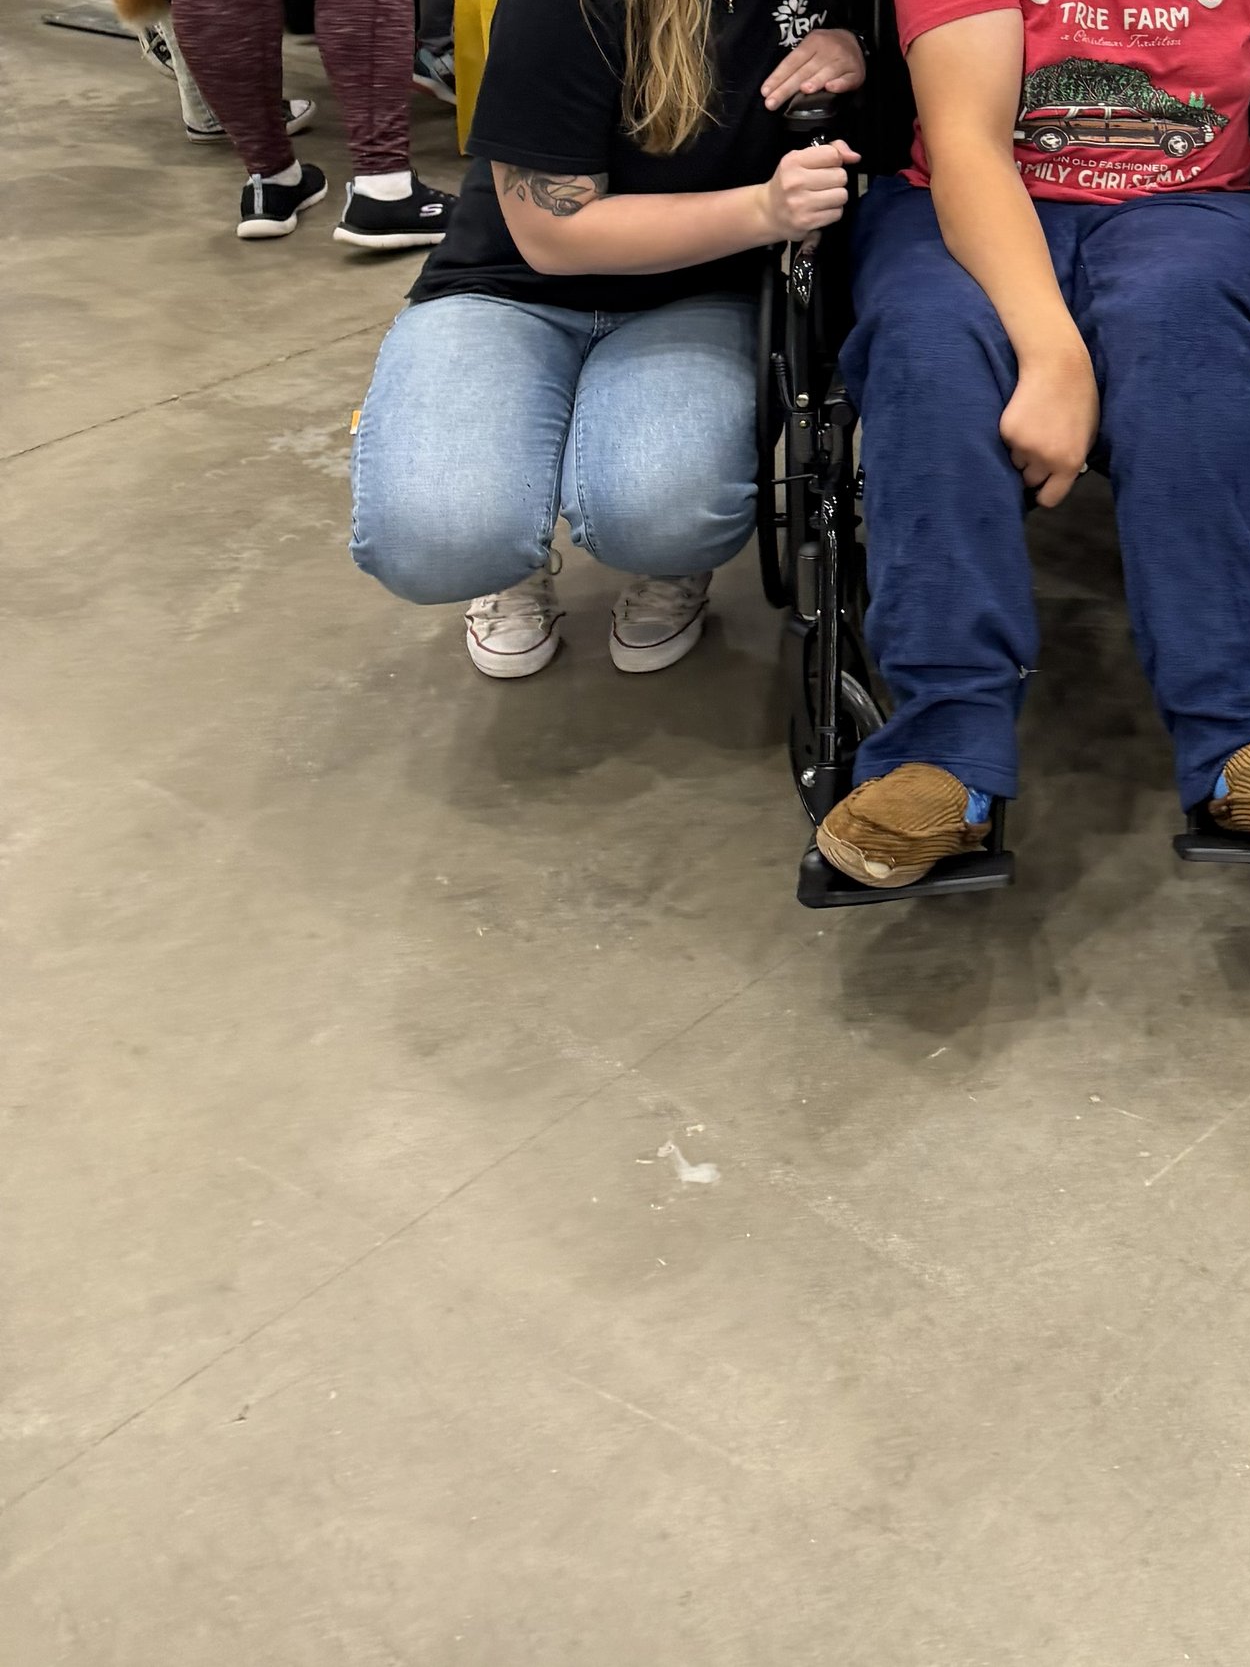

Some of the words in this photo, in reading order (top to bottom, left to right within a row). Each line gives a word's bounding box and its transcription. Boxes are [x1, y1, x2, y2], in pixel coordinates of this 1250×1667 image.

[1060, 1, 1110, 30] TREE
[1123, 6, 1190, 32] FARM
[1126, 33, 1181, 48] Tradition
[1015, 160, 1072, 184] AMILY
[1072, 158, 1097, 168] OLD
[1099, 160, 1169, 173] FASHIONED
